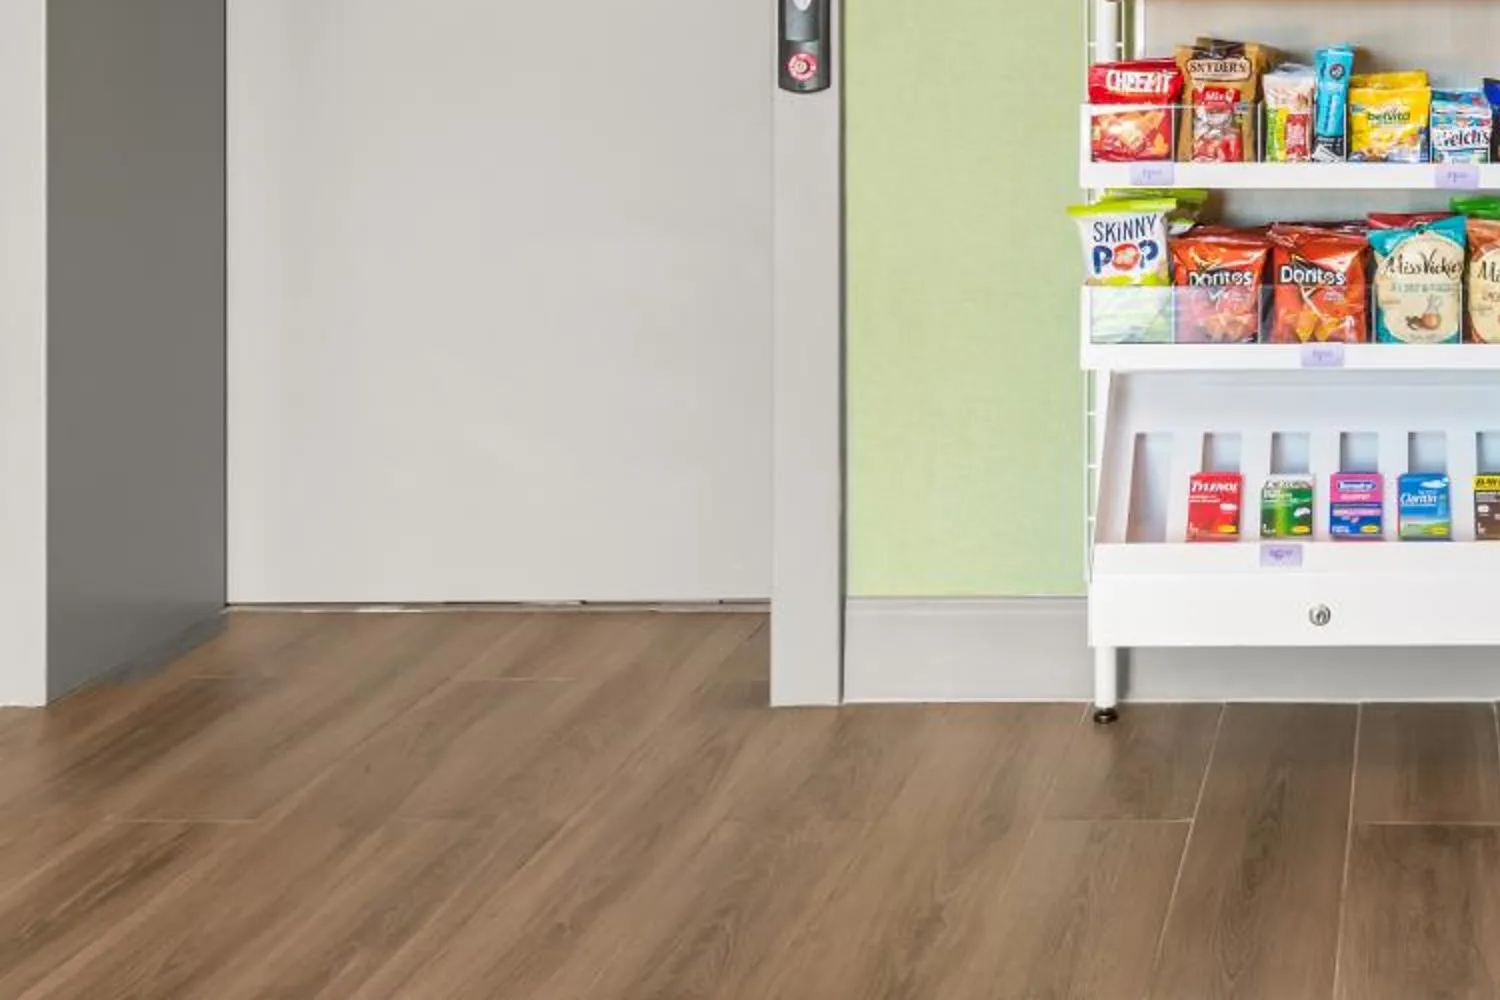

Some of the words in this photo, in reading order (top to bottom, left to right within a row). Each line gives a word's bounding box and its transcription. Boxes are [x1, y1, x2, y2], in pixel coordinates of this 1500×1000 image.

[1093, 215, 1157, 243] SKINNY
[1093, 240, 1159, 275] POP
[1189, 270, 1253, 287] Doritos
[1280, 265, 1346, 285] Doritos
[1191, 481, 1238, 493] TYLENOL
